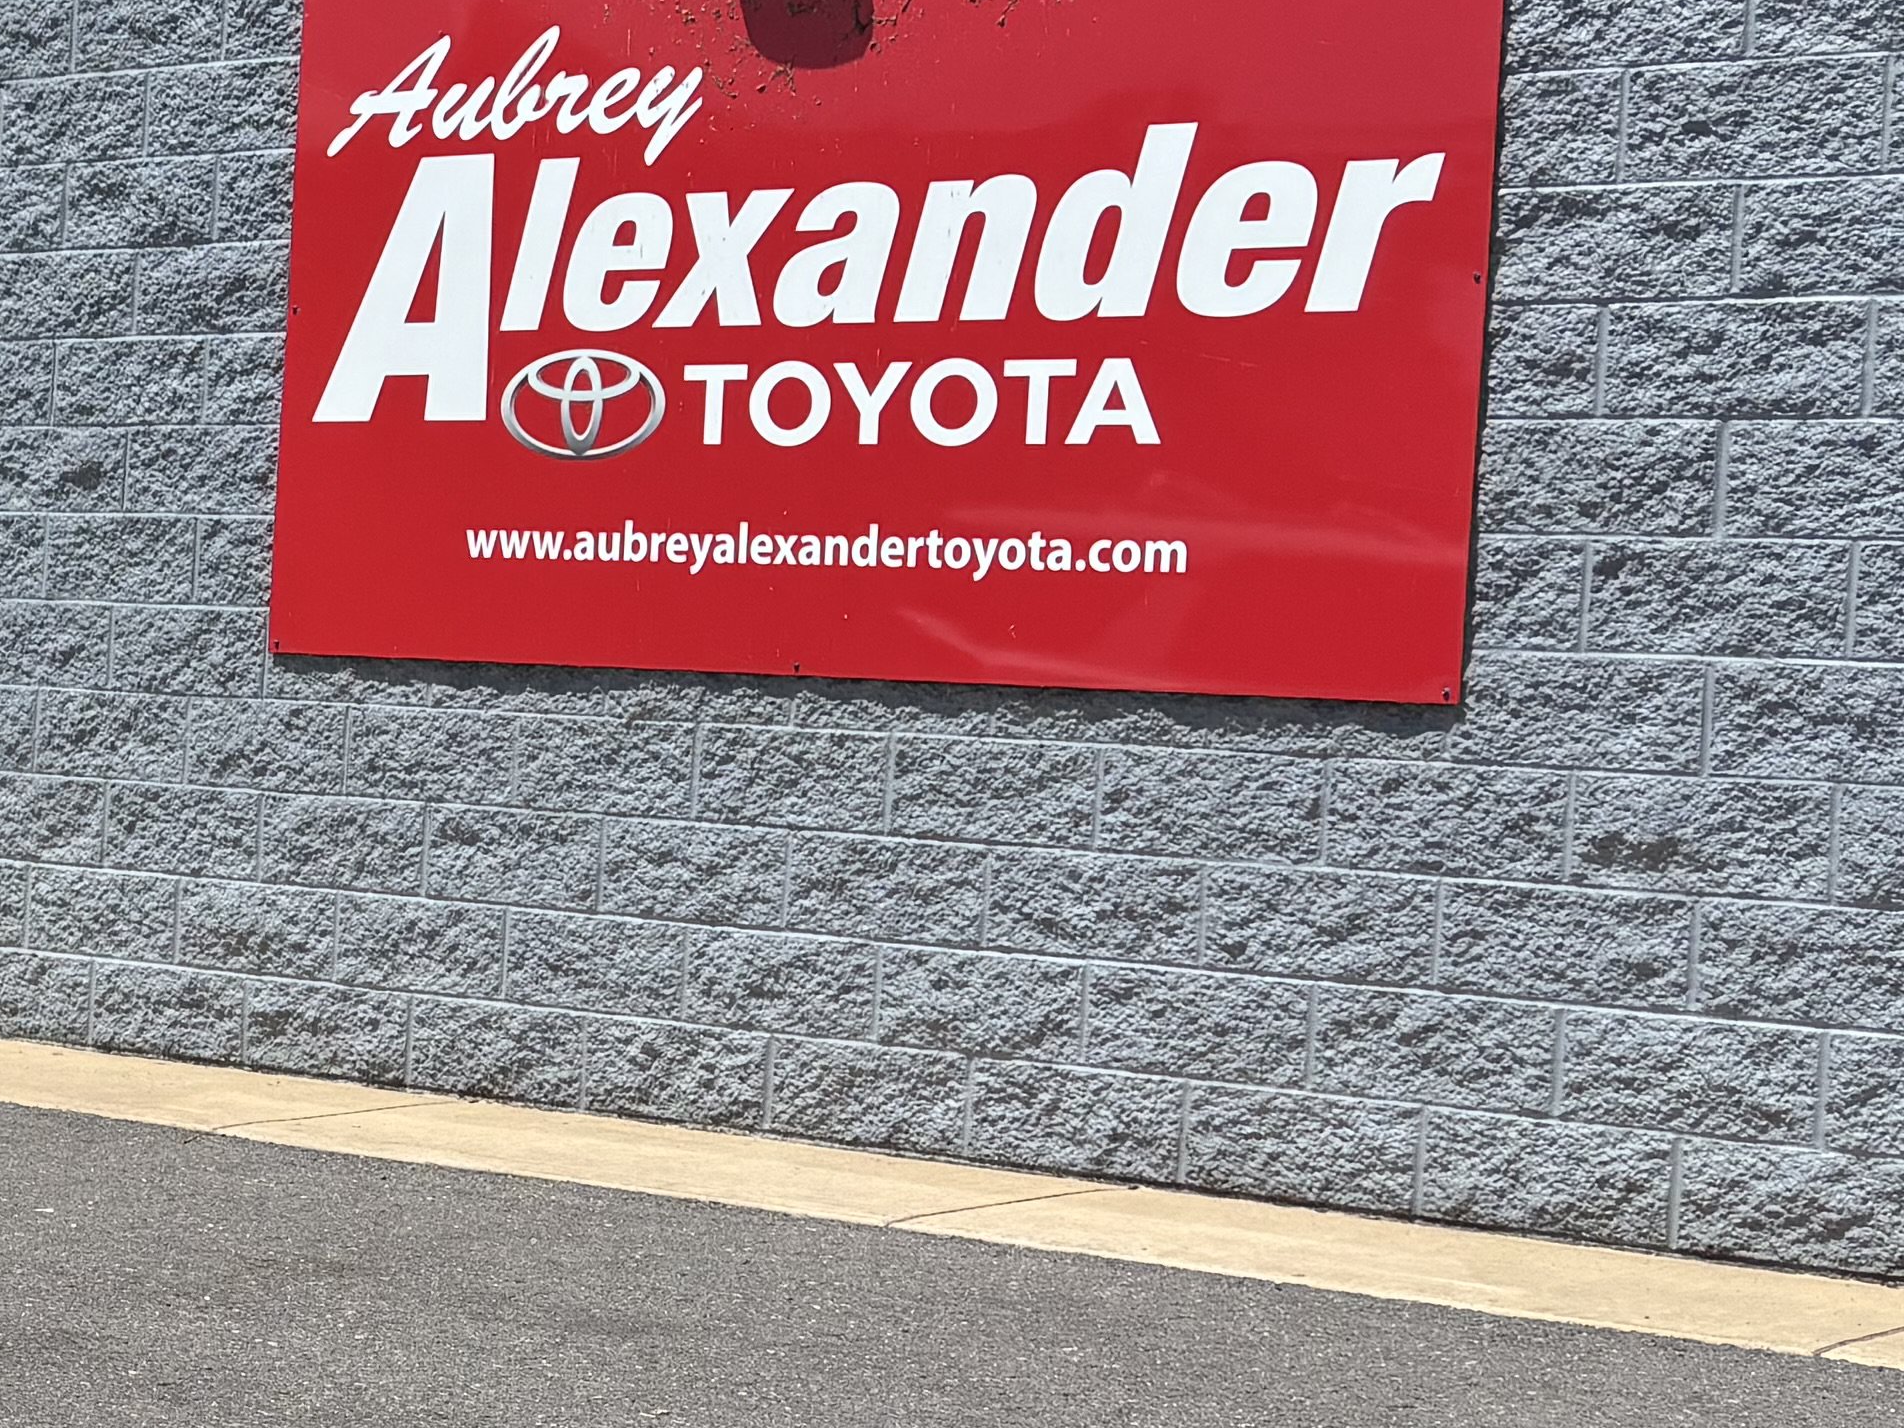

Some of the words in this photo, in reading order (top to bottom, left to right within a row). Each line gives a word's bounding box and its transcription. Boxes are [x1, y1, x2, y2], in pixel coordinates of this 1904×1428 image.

[327, 26, 703, 166] Aubrey
[312, 122, 1445, 422] Alexander
[684, 358, 1161, 447] TOYOTA
[466, 520, 1188, 582] www.aubreyalexandertoyota.com
